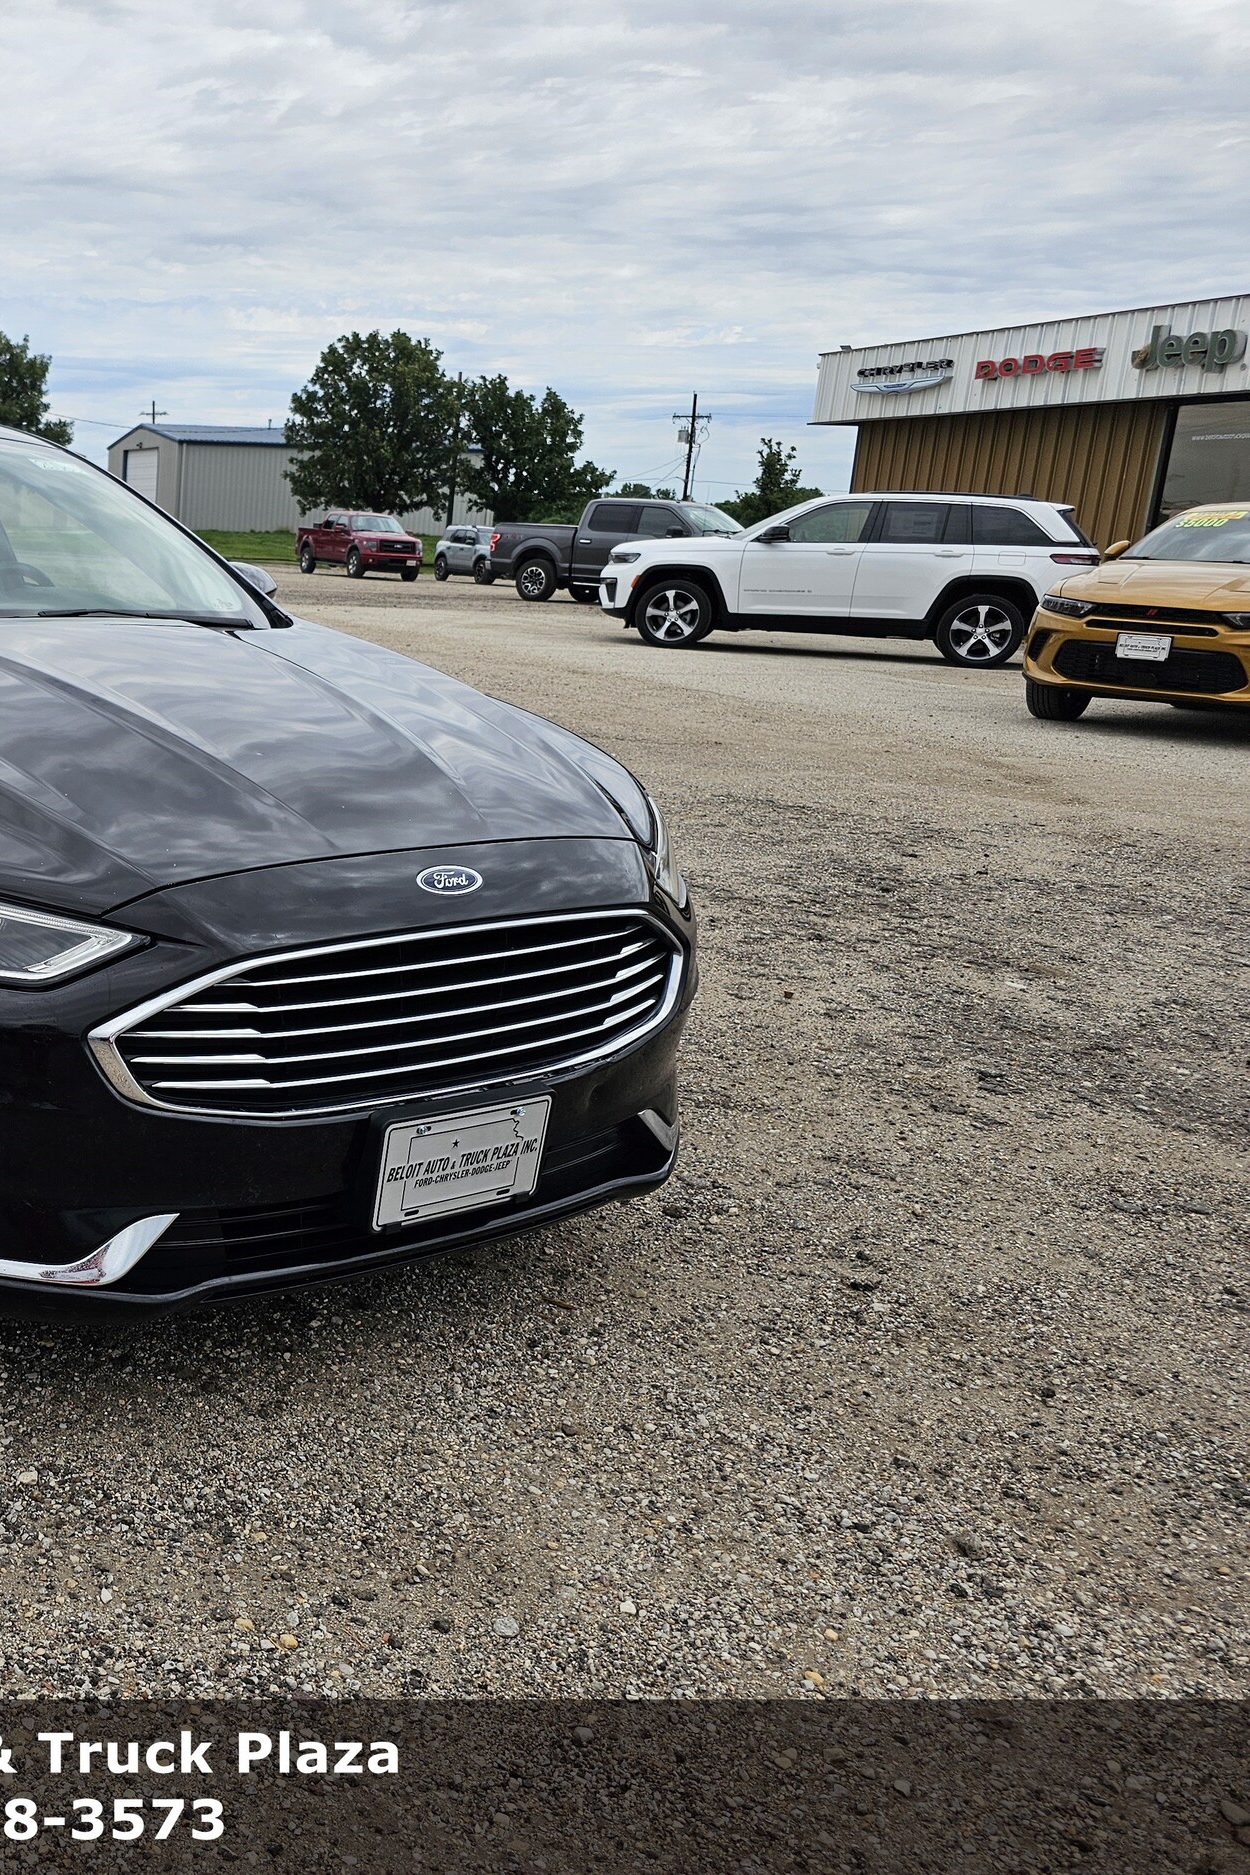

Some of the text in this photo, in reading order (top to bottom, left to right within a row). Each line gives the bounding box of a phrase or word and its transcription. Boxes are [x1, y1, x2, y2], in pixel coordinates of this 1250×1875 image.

[974, 347, 1104, 380] DODGE
[1131, 325, 1242, 374] Jeep
[857, 359, 954, 377] CHRYSLER
[433, 871, 469, 889] Ford
[386, 1138, 538, 1182] BELOIT AUTO & TRUCK PLAZA INC.
